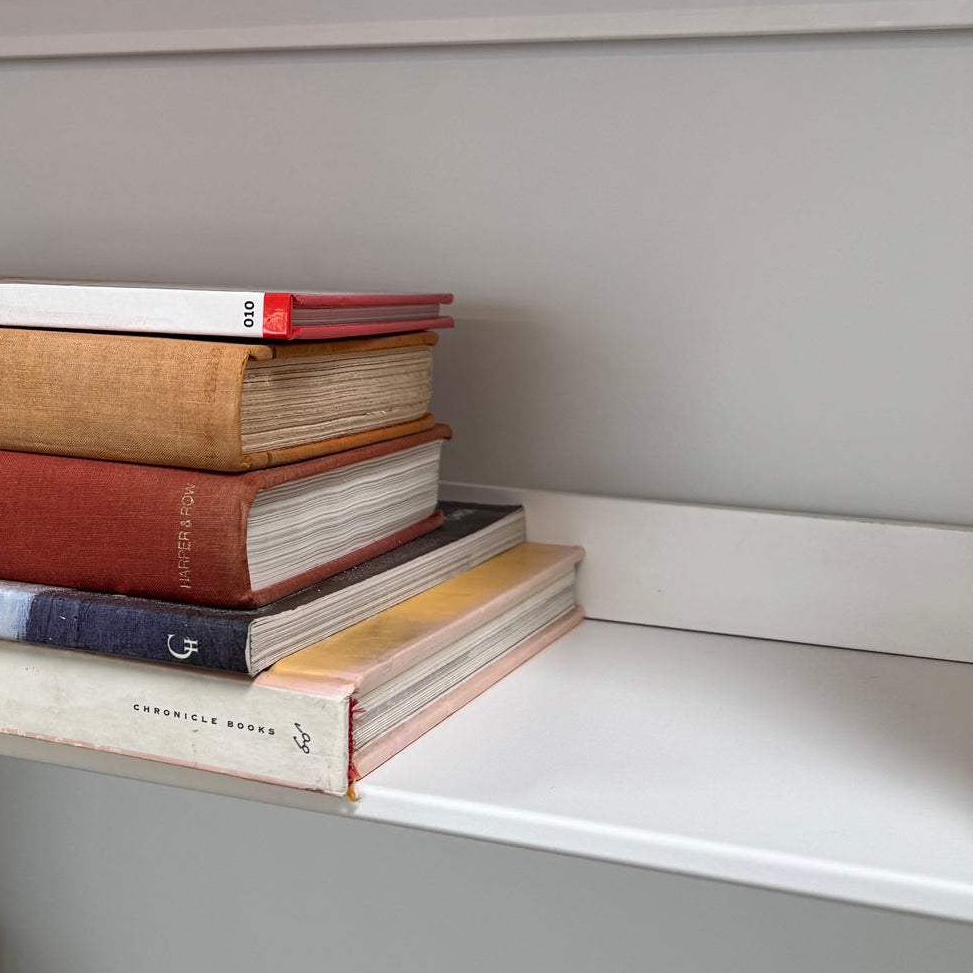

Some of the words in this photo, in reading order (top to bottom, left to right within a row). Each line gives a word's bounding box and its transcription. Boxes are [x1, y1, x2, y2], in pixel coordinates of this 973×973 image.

[244, 301, 255, 328] 010
[180, 482, 196, 517] ROW
[178, 530, 192, 589] HARPER
[133, 704, 217, 725] CHRONICLE
[227, 720, 276, 736] BOOKS
